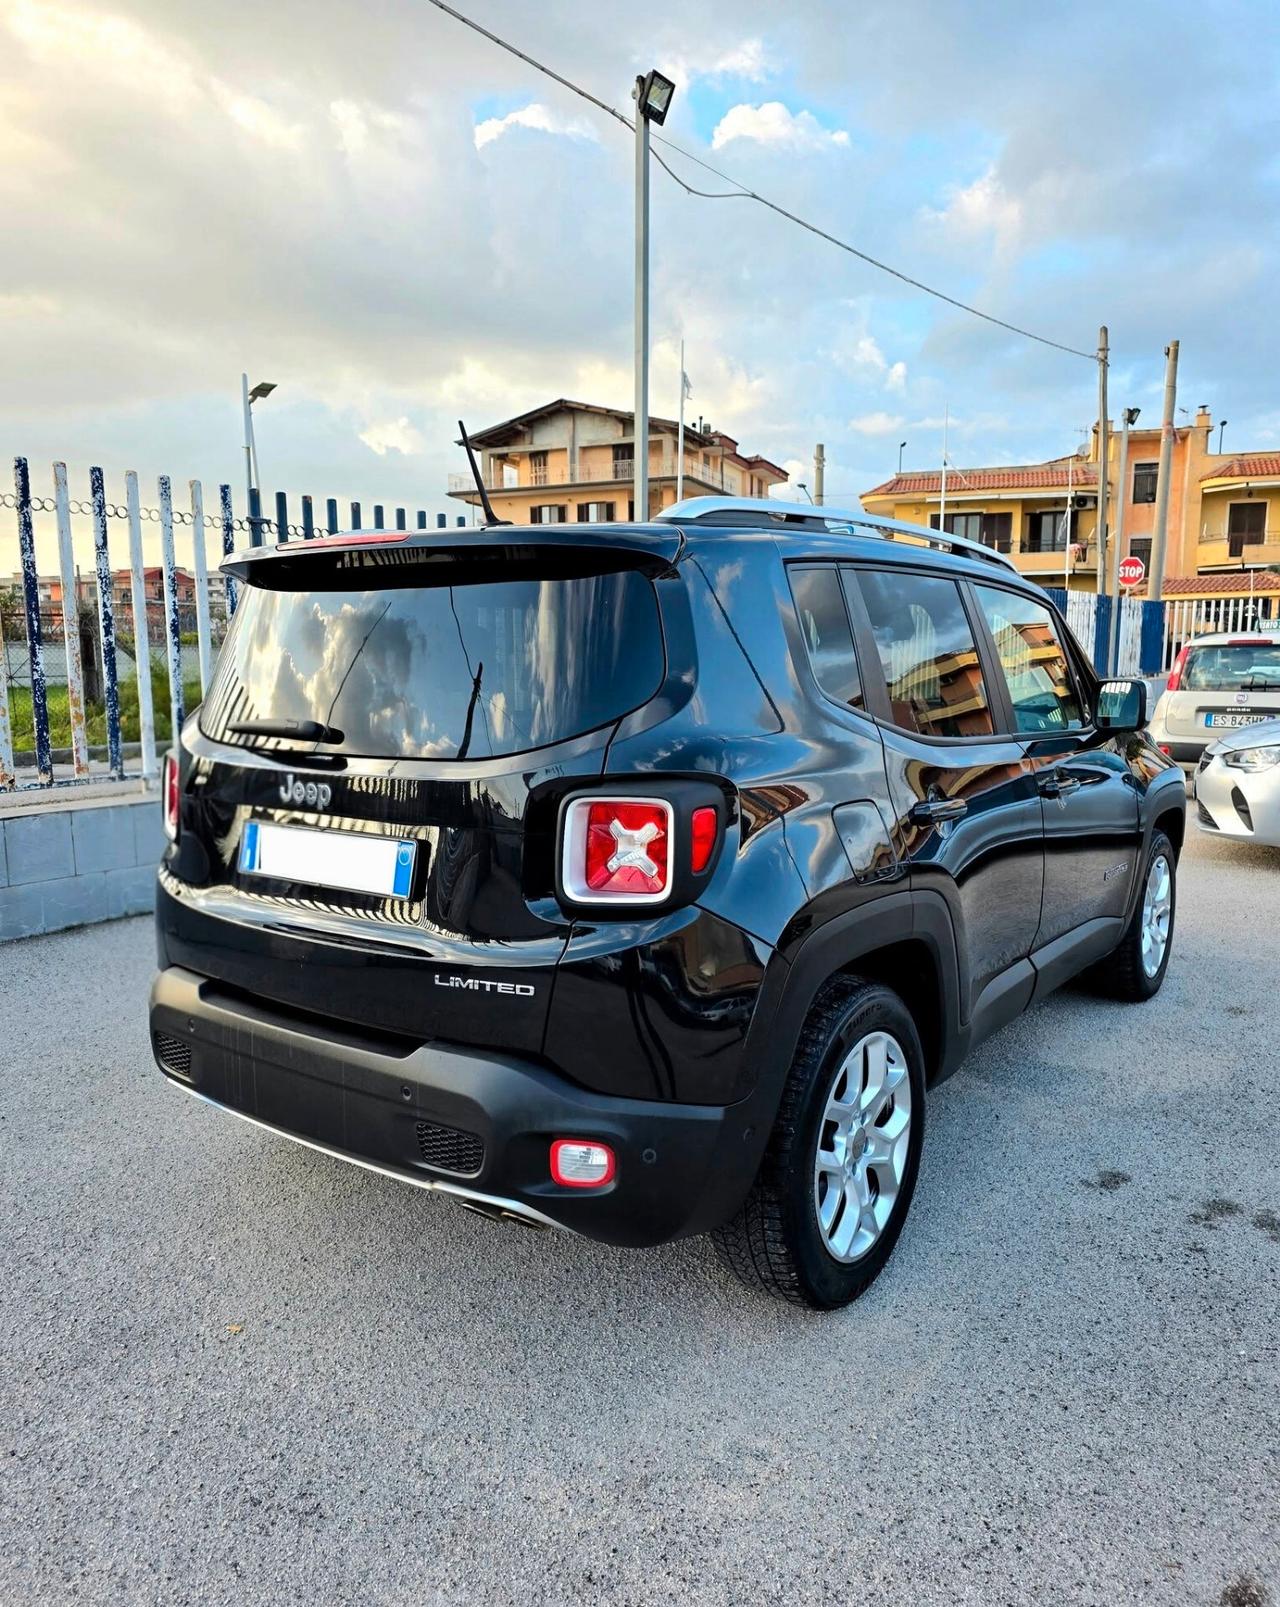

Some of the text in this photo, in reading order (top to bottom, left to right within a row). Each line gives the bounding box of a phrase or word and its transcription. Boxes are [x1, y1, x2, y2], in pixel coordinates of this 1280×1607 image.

[1118, 566, 1143, 578] STOP
[1213, 715, 1227, 726] ES
[279, 774, 332, 811] Jeep
[434, 974, 535, 996] LIMITED
